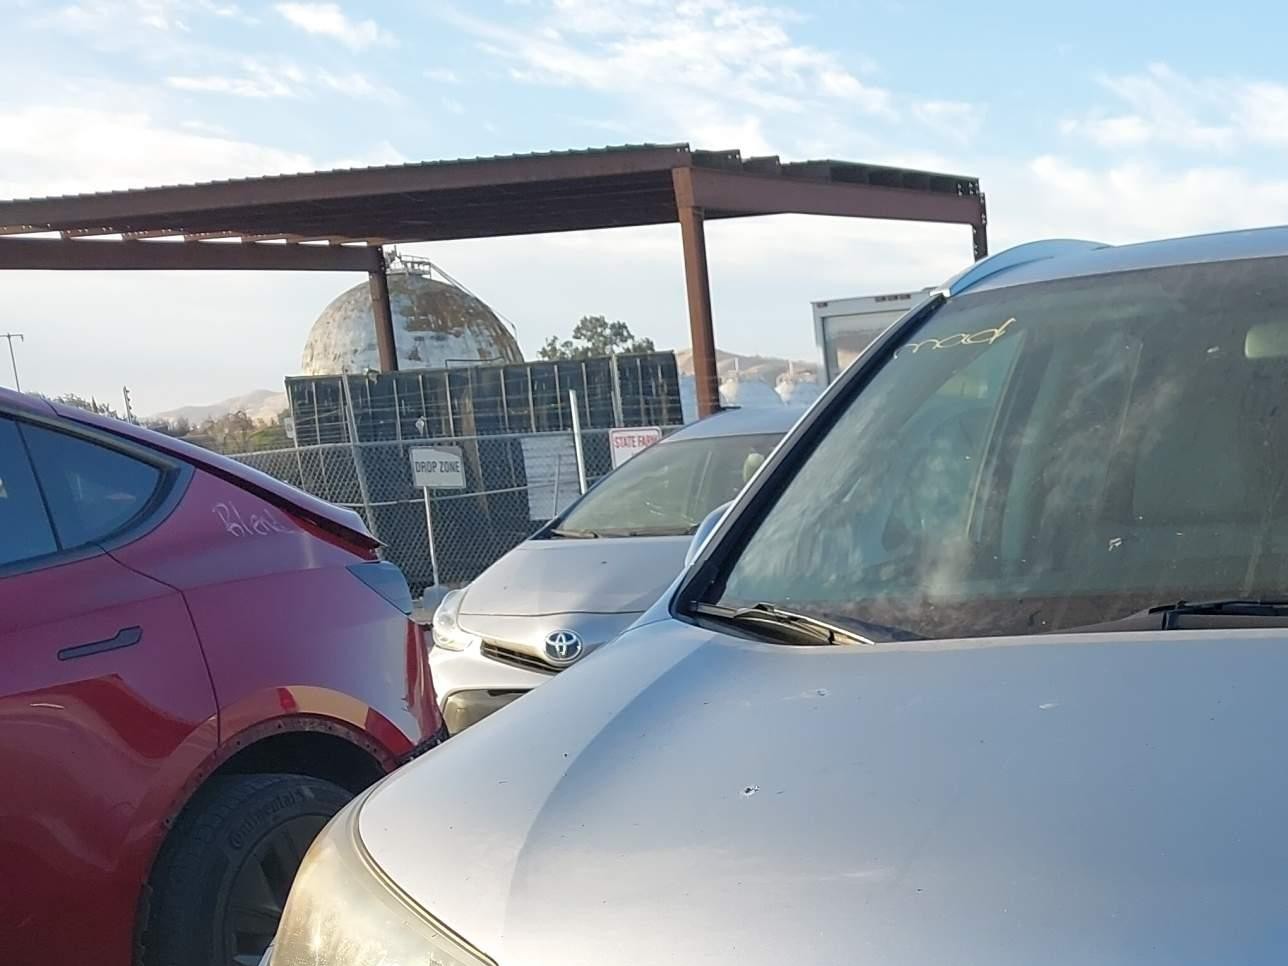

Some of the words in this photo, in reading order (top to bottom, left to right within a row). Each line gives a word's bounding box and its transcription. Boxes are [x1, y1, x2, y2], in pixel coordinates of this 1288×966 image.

[613, 436, 637, 448] STATE
[415, 461, 437, 472] DROP
[440, 461, 460, 472] ZONE
